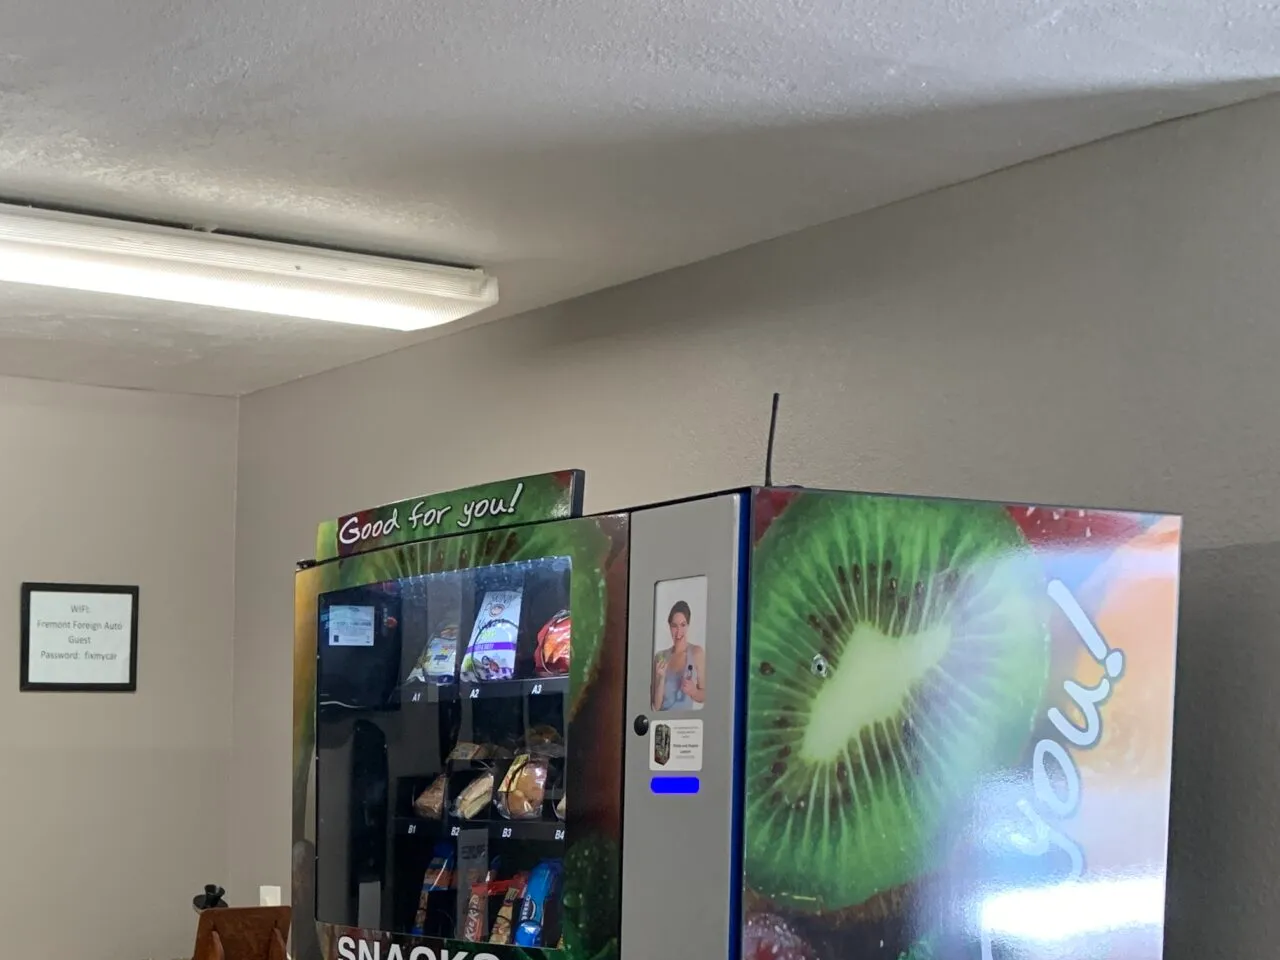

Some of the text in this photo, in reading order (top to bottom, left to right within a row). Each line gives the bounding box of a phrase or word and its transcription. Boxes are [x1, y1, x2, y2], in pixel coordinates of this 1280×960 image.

[338, 482, 523, 545] Good for you!
[37, 619, 123, 631] Fremont Foreign Auto
[68, 635, 91, 645] Guest
[40, 650, 80, 660] Password:
[470, 688, 480, 698] A2
[531, 684, 542, 695] A3
[412, 692, 421, 702] A1
[1015, 578, 1124, 884] you!
[408, 824, 416, 834] B1
[451, 826, 461, 836] B2
[502, 828, 512, 838] B3
[554, 829, 565, 840] B4
